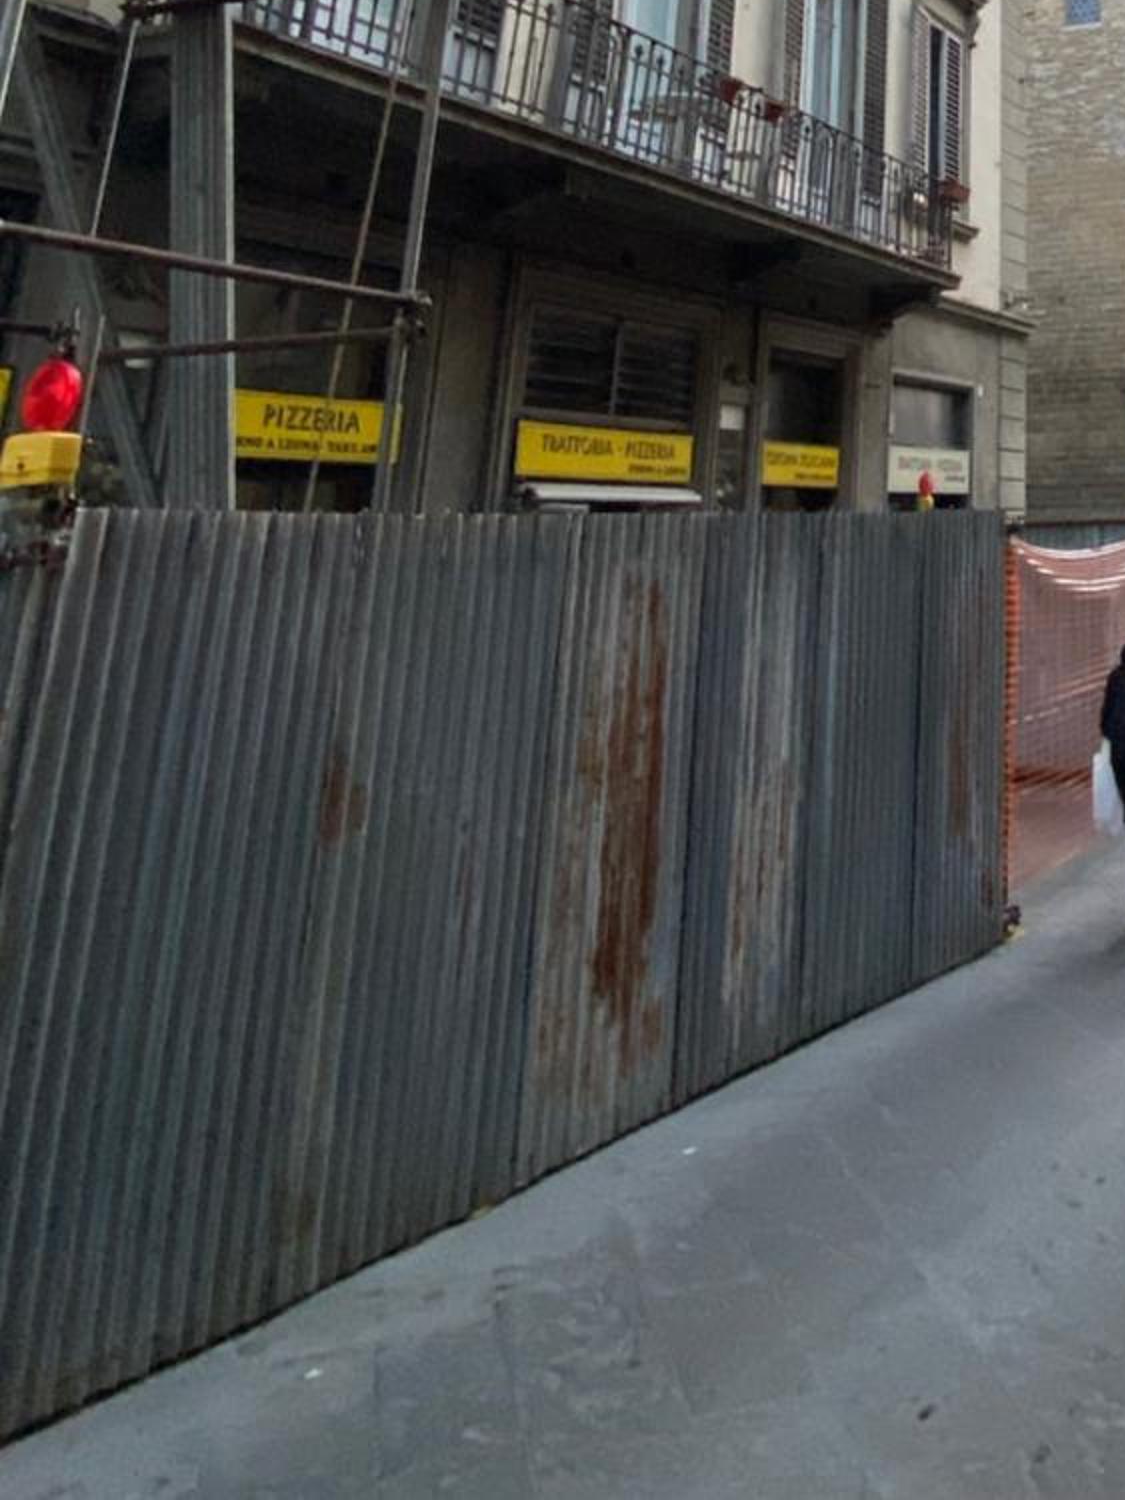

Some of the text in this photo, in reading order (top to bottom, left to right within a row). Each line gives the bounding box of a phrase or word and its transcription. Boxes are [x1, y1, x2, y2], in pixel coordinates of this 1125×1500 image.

[262, 403, 360, 434] PIZZERIA
[542, 434, 615, 455] TRATTORIA
[624, 440, 675, 460] PIZZERIA
